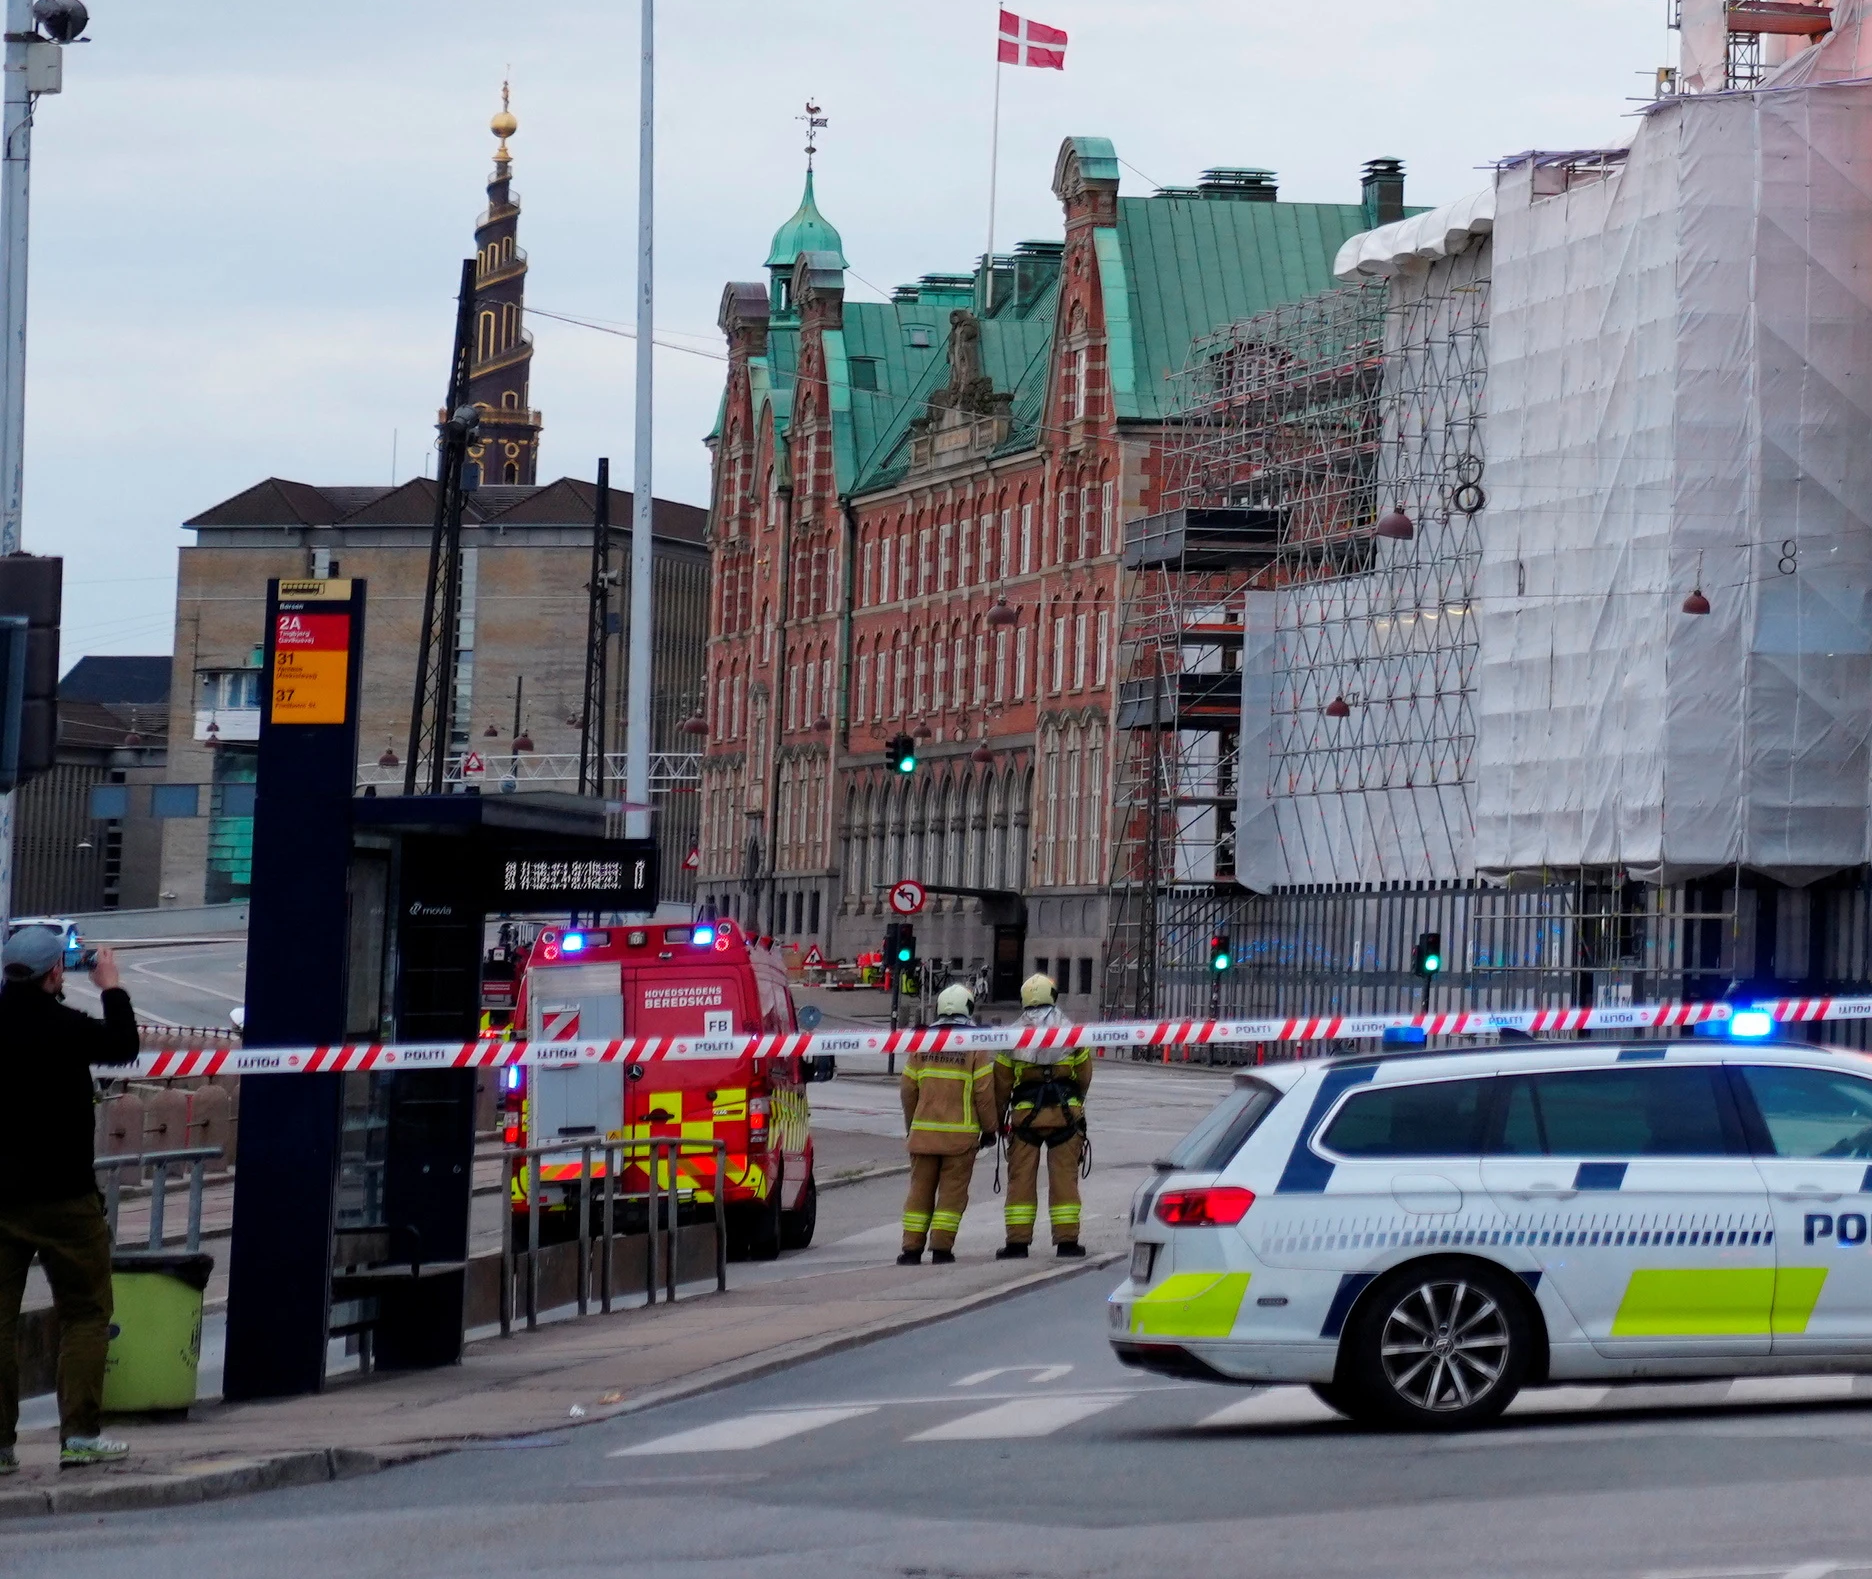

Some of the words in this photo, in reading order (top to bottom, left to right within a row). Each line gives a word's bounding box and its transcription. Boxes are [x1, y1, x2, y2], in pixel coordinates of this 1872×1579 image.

[279, 615, 301, 631] 2A
[277, 652, 295, 666] 31
[275, 689, 296, 703] 37
[423, 905, 452, 916] movia
[644, 986, 722, 998] HOVEDSTADENS
[644, 994, 723, 1010] BEREDSKAB
[1838, 1003, 1872, 1015] POLITI
[708, 1019, 729, 1033] FB
[1488, 1015, 1524, 1027] POLITI
[1235, 1023, 1272, 1035] POLITI
[971, 1033, 1010, 1044] POLITI
[1092, 1030, 1129, 1043] POLITI
[694, 1042, 735, 1053] POLITI
[821, 1037, 860, 1051] POLITI
[404, 1048, 446, 1062] POLITI
[537, 1046, 578, 1060] POLITI
[236, 1056, 281, 1069] POLITI
